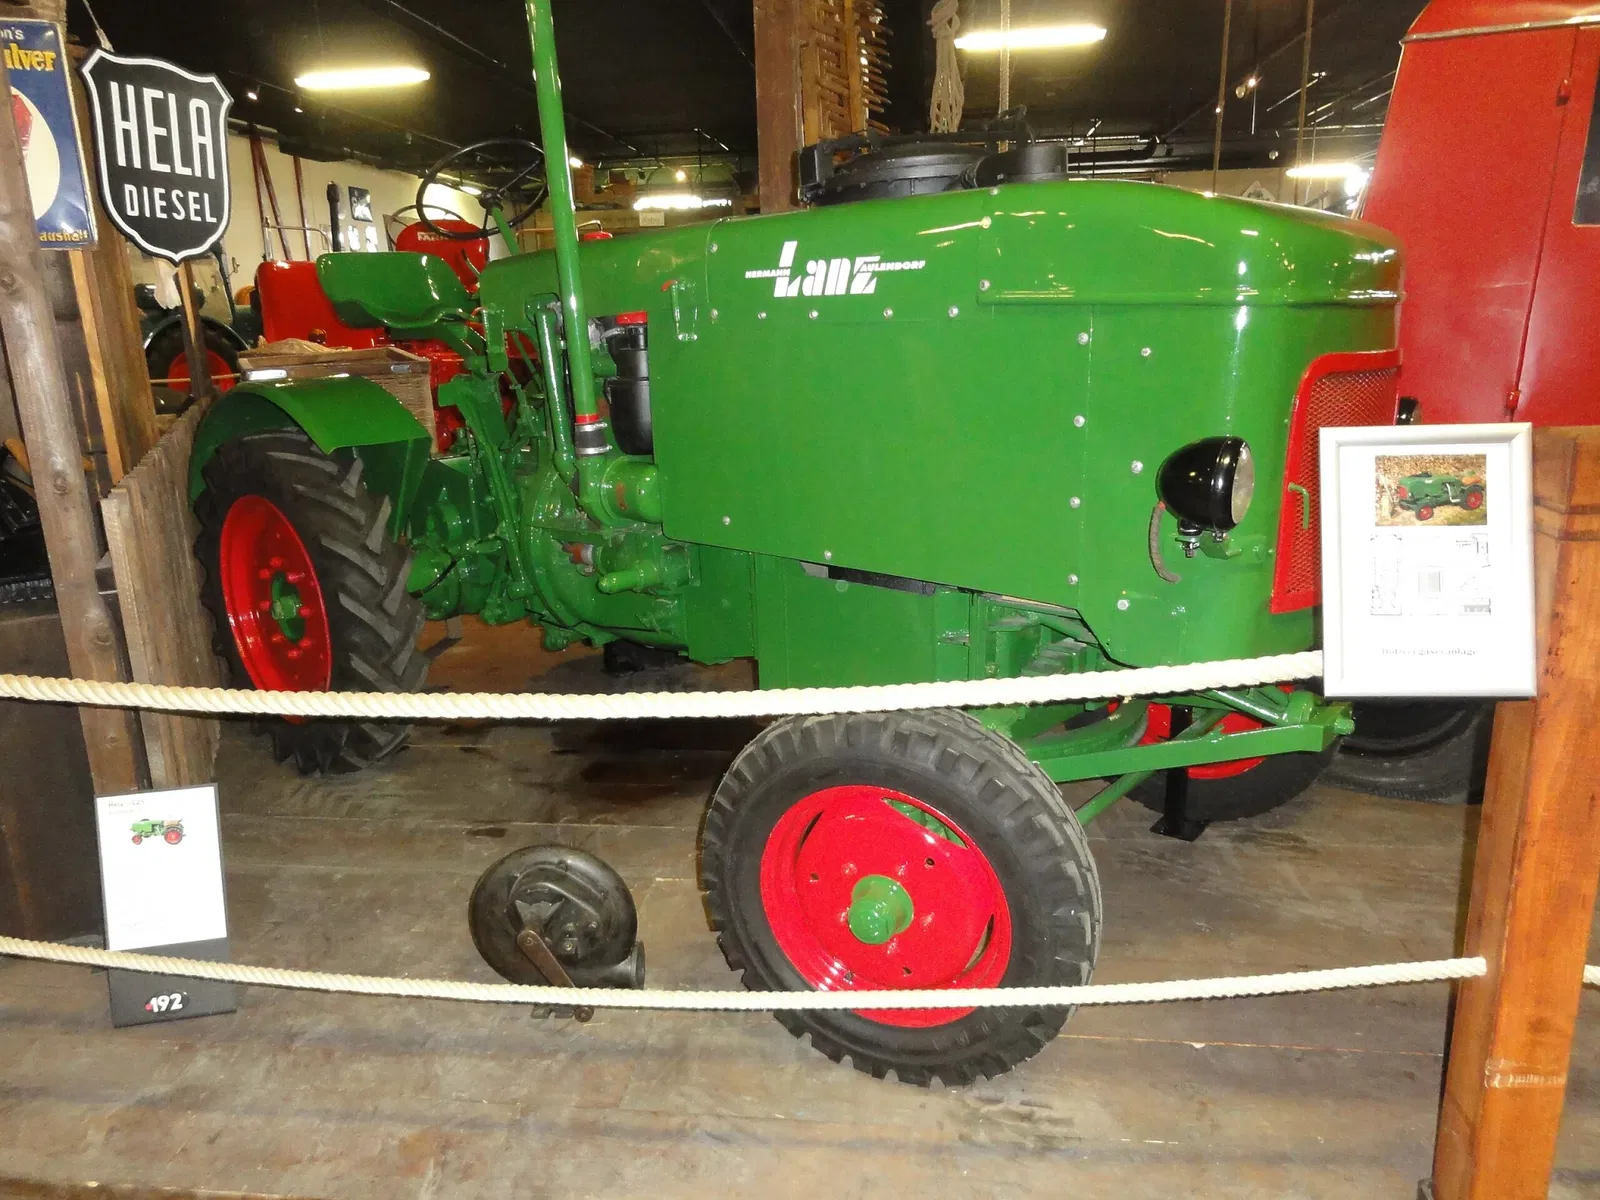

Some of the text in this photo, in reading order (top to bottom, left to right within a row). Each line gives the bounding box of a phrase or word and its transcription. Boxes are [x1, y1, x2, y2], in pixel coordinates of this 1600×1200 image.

[109, 80, 216, 180] HELA
[124, 183, 218, 224] DIESEL
[745, 240, 926, 298] HERMANN Lanz AULENDORF
[150, 992, 183, 1013] 192
